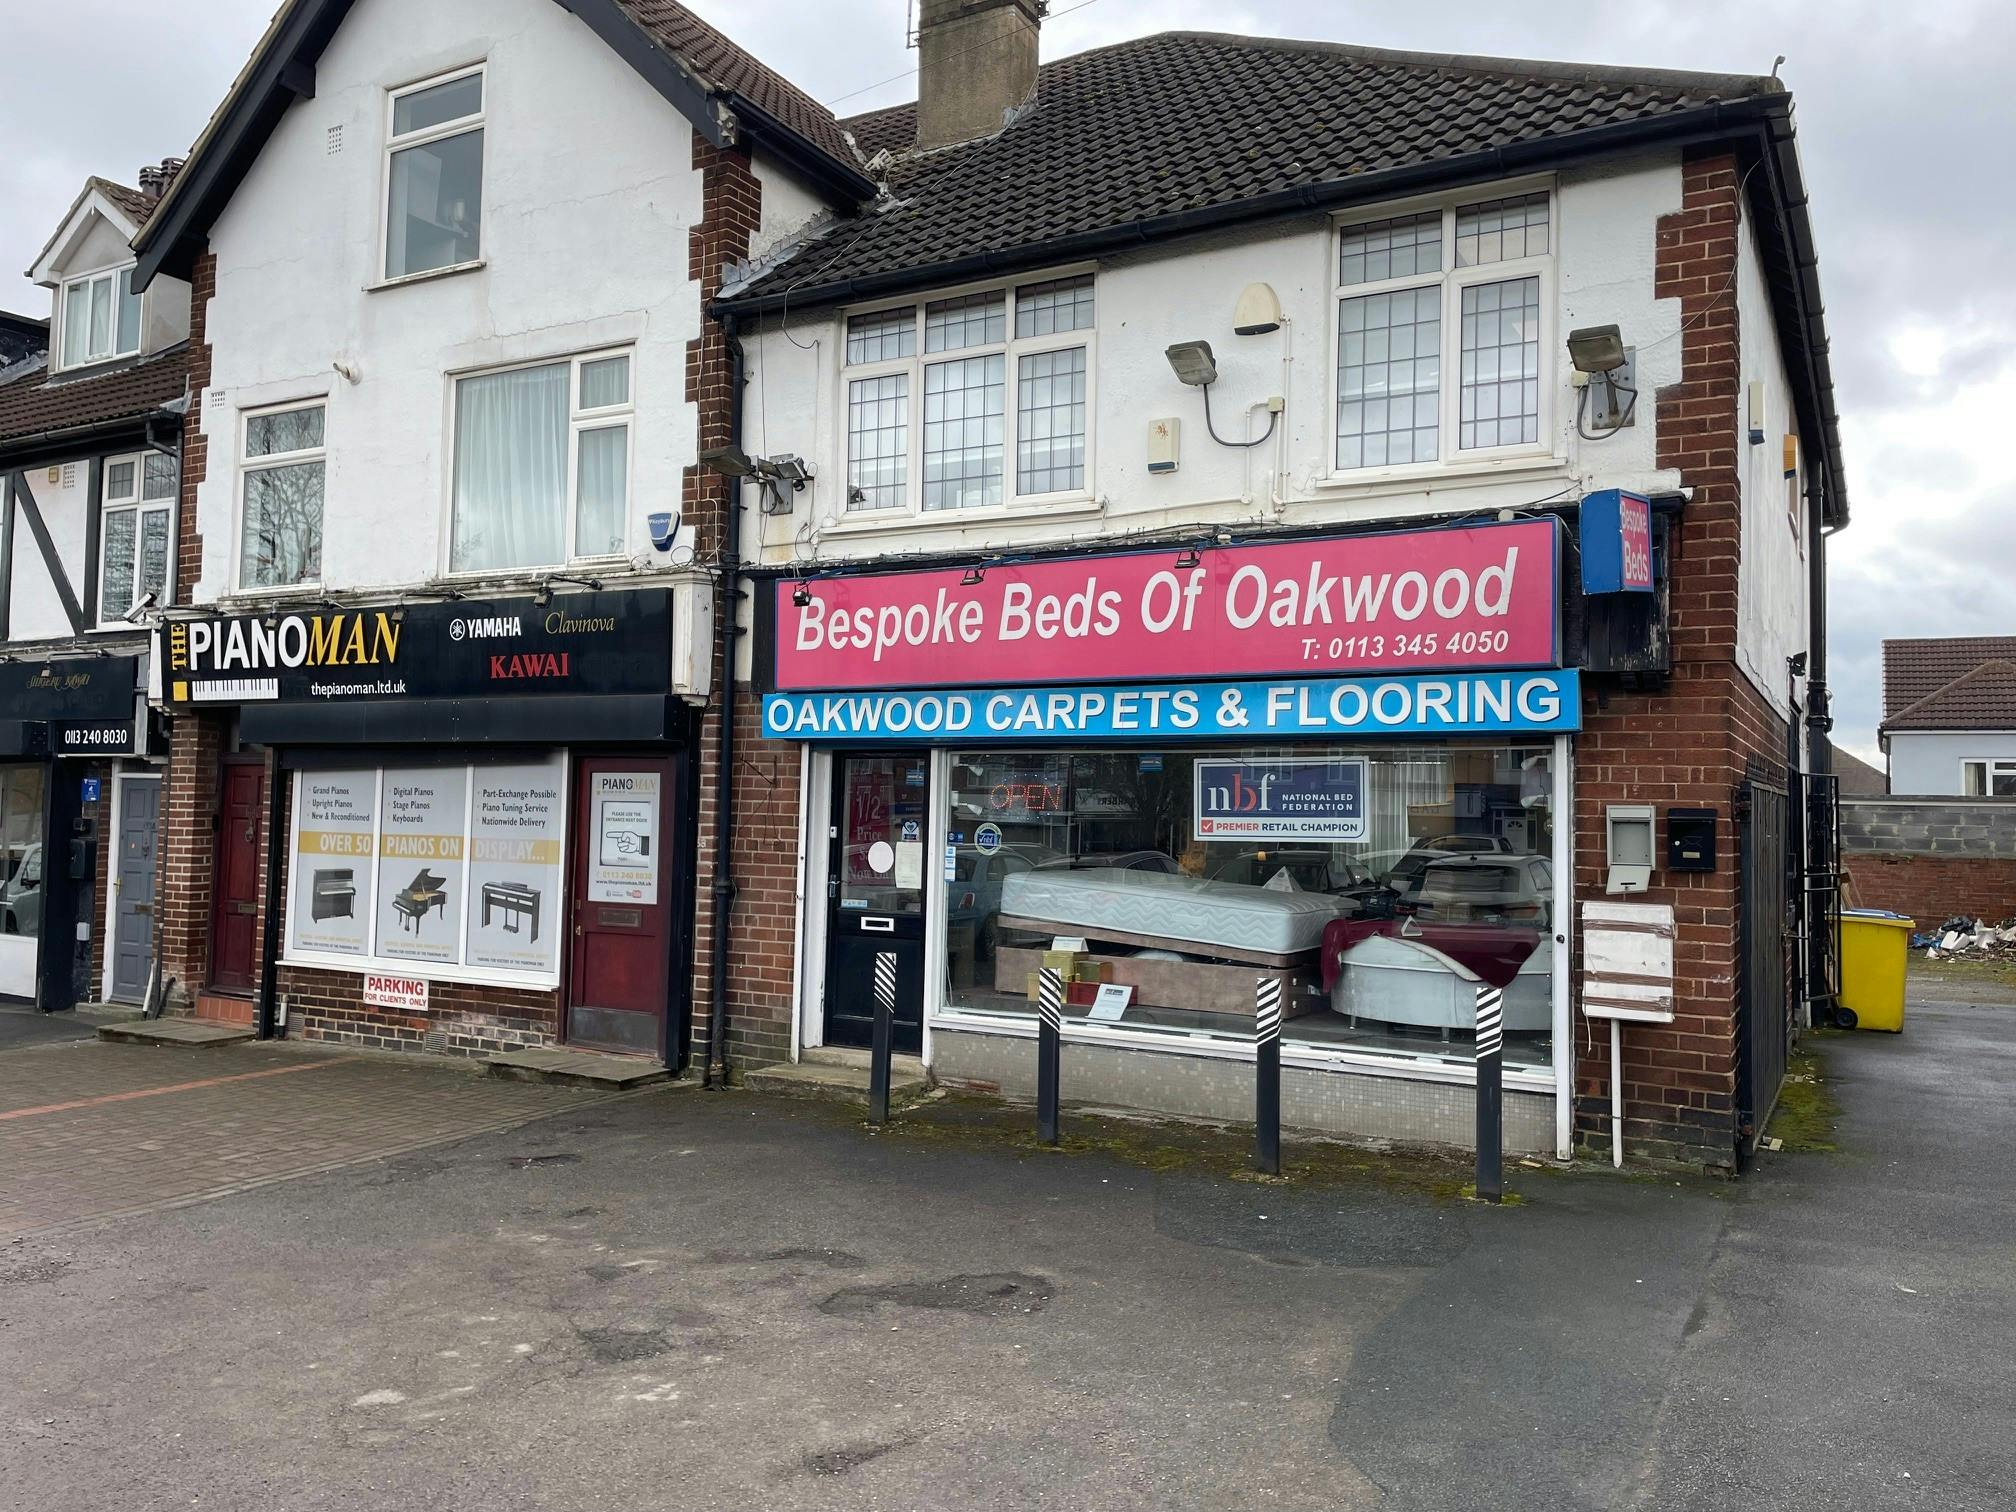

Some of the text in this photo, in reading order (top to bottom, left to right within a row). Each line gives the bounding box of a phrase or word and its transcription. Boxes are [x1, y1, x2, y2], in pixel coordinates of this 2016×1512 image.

[1621, 500, 1648, 538] Bespoke
[1623, 541, 1649, 582] Beds
[796, 546, 1519, 662] Bespoke Beds Of Oakwood
[467, 611, 616, 638] YAMAHA Clavinova
[170, 623, 187, 671] THE
[1301, 630, 1500, 660] T: 0113 345 4050
[490, 653, 569, 679] KAWAI
[310, 679, 407, 699] thepianoman.ltd.uk
[768, 677, 1561, 732] OAKWOOD CARPETS & FLOORING
[65, 729, 127, 744] 0113 240 8030
[312, 786, 350, 795] Grand Pianos
[393, 787, 434, 798] Digital Pianos
[482, 788, 557, 800] Part-Exchange Possible
[991, 784, 1061, 811] OPEN
[1207, 772, 1276, 812] nbf
[1282, 793, 1354, 802] NATIONAL BED
[312, 799, 353, 810] Upright Pianos
[393, 800, 430, 811] Stage Pianos
[482, 803, 549, 814] Piano Tuning Service
[1282, 803, 1354, 811] FEDERATION
[311, 811, 370, 821] New & Reconditioned
[392, 813, 424, 824] Keyboards
[481, 816, 546, 829] Nationwide Delivery
[1216, 823, 1358, 832] PREMIER RETAIL CHAMPION
[320, 833, 353, 852] OVER
[355, 835, 372, 853] 50
[387, 836, 435, 856] PIANOS
[439, 837, 459, 857] ON
[368, 976, 424, 996] PARKING
[364, 992, 427, 1008] FOR CLIENTS ONLY
